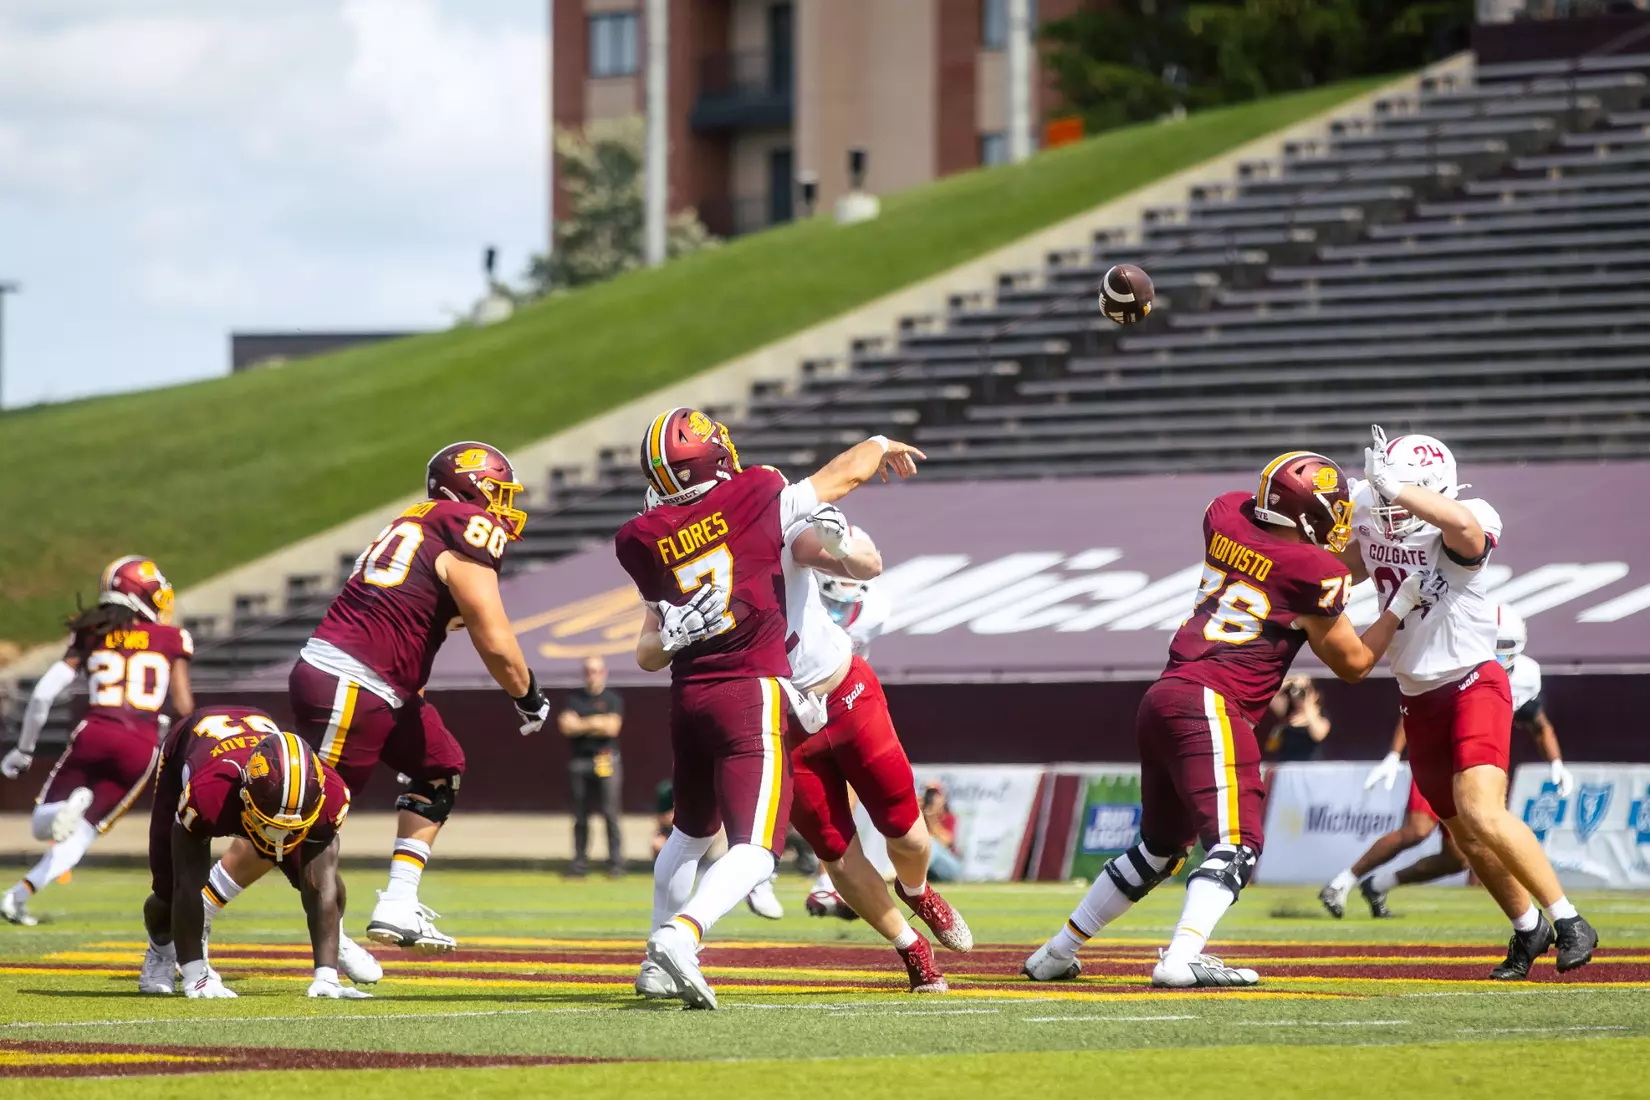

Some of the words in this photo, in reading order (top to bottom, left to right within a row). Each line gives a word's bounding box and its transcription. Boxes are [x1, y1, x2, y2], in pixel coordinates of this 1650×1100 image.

[1413, 444, 1445, 467] 24
[463, 515, 507, 559] 60
[657, 511, 729, 565] FLORES
[1208, 531, 1273, 582] KOIVISTO
[1369, 544, 1428, 566] COLGATE
[672, 542, 736, 640] 7
[1181, 562, 1272, 646] 76
[87, 649, 170, 712] 20
